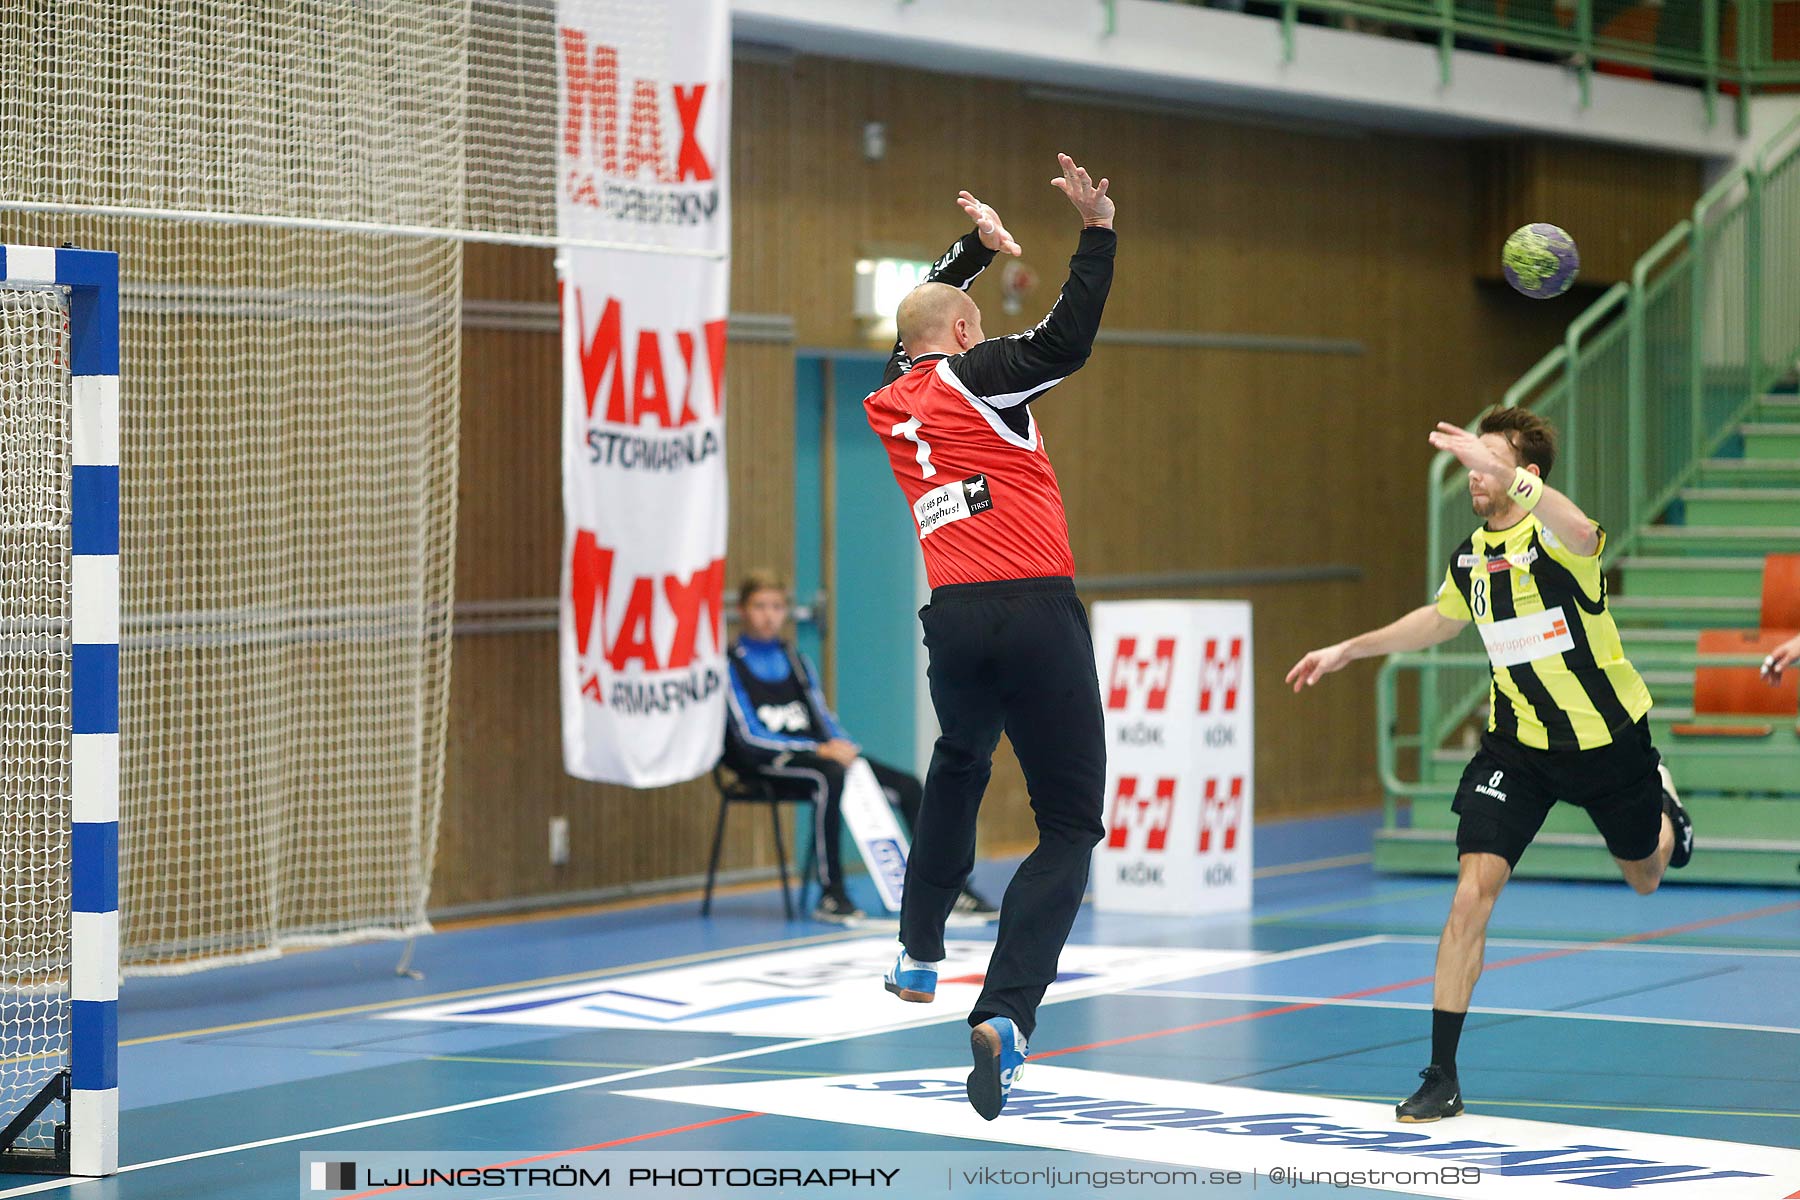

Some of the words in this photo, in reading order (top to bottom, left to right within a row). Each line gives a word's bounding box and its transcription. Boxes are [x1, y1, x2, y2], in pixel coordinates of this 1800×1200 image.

[891, 415, 937, 480] 1
[936, 491, 949, 506] på
[970, 499, 989, 512] FIRST
[1473, 577, 1488, 618] 8
[1488, 769, 1504, 789] 8
